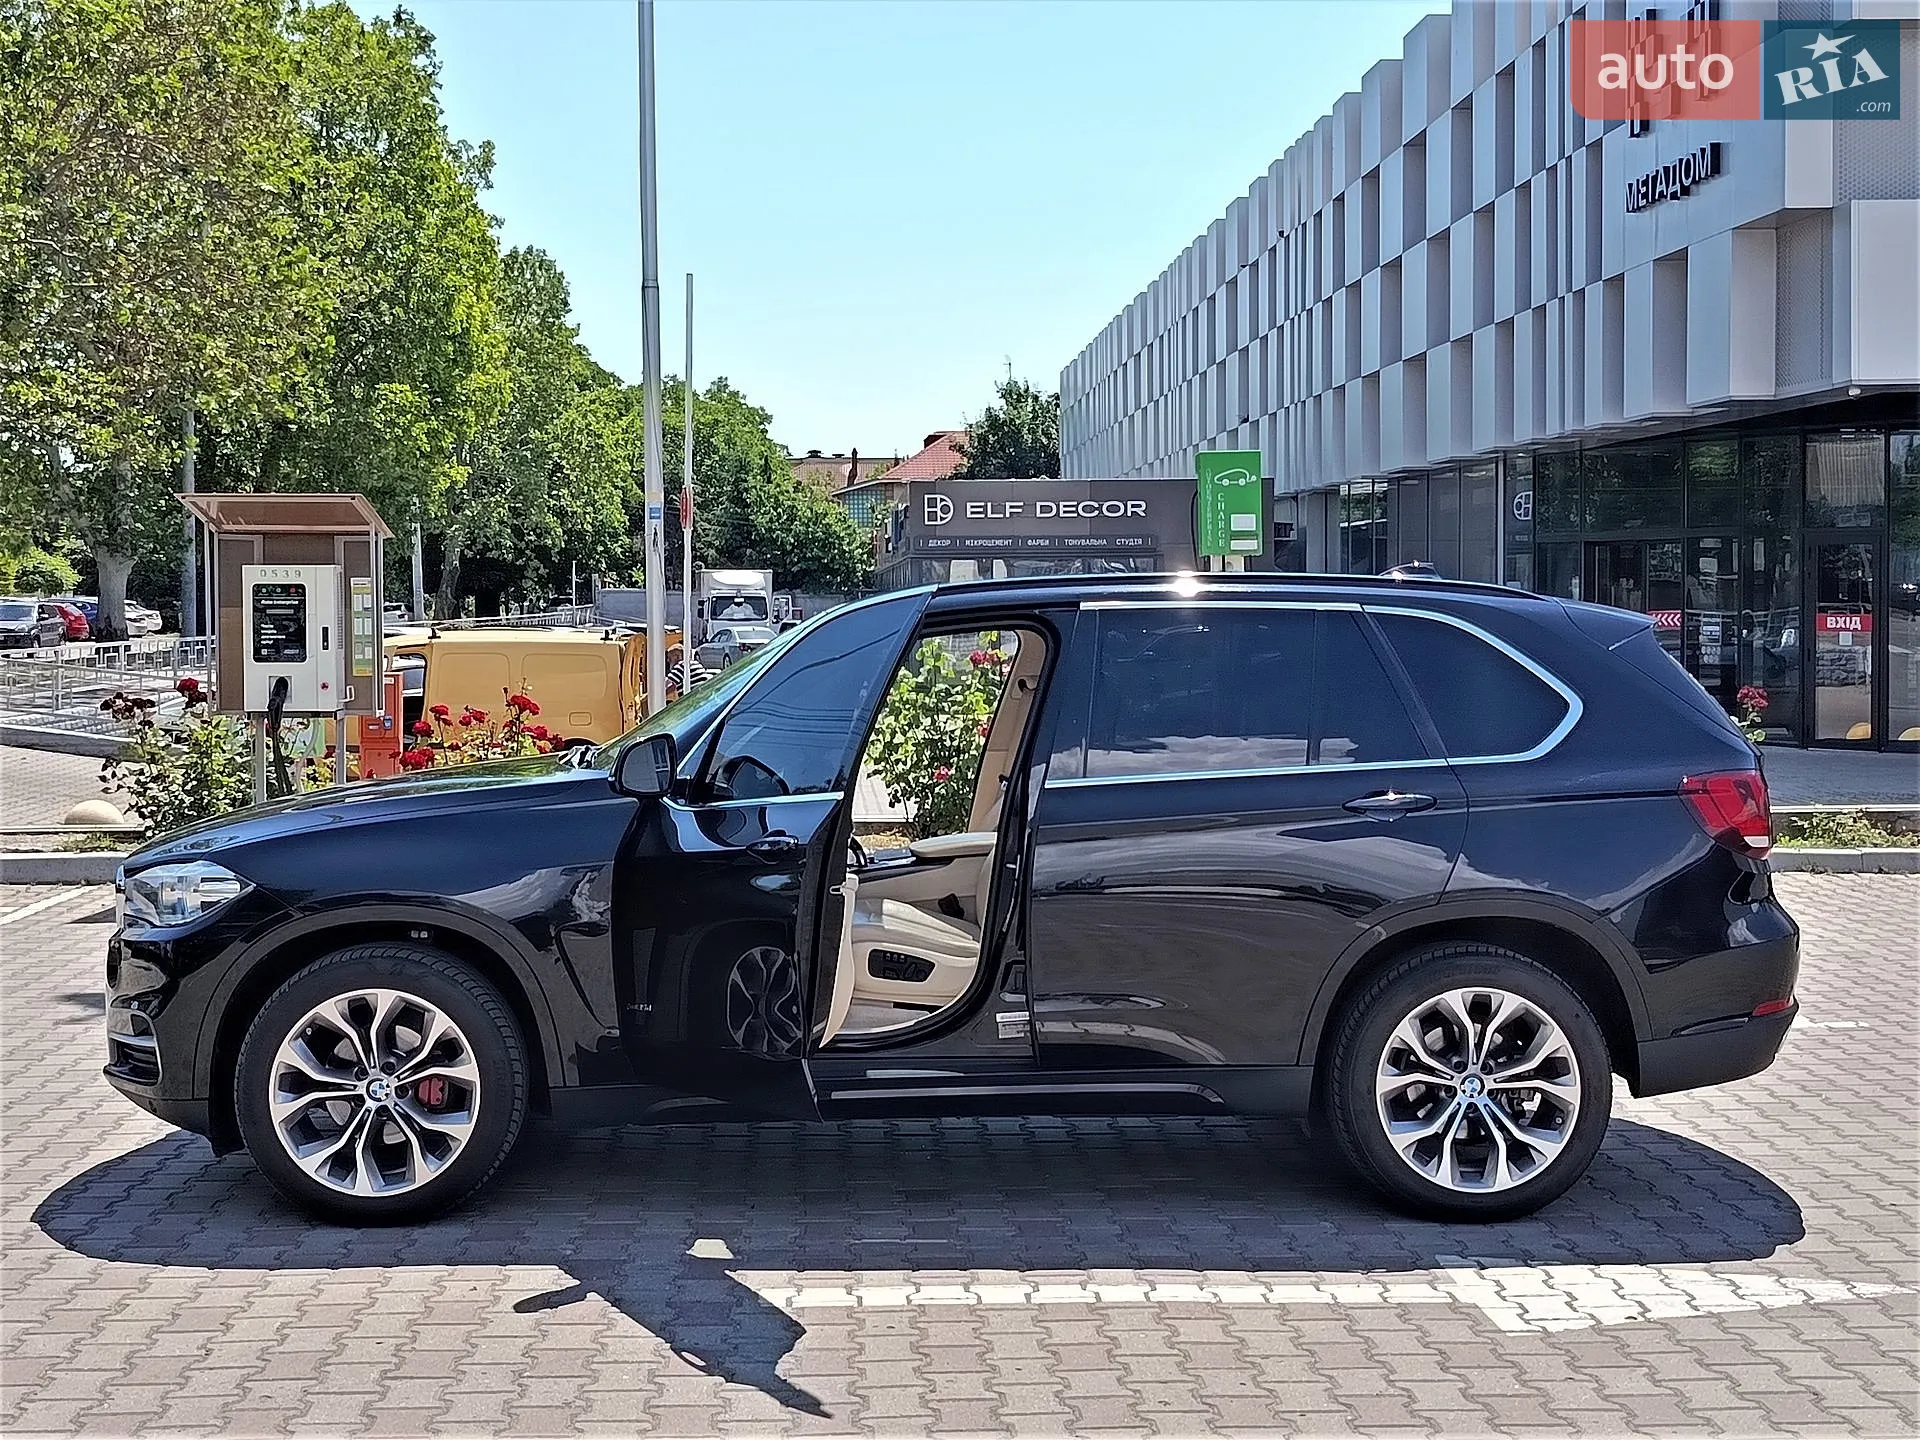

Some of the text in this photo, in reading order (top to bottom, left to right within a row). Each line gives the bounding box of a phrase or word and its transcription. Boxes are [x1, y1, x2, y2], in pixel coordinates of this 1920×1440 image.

[1624, 141, 1721, 214] МЕГАДОМ
[965, 500, 1148, 519] ELF DECOR
[1217, 492, 1226, 547] CHARGE
[928, 539, 951, 547] ДЕКОР
[1027, 539, 1050, 547] ФАРБИ
[1115, 538, 1143, 546] СТУДІЯ
[1826, 616, 1862, 631] ВХІД
